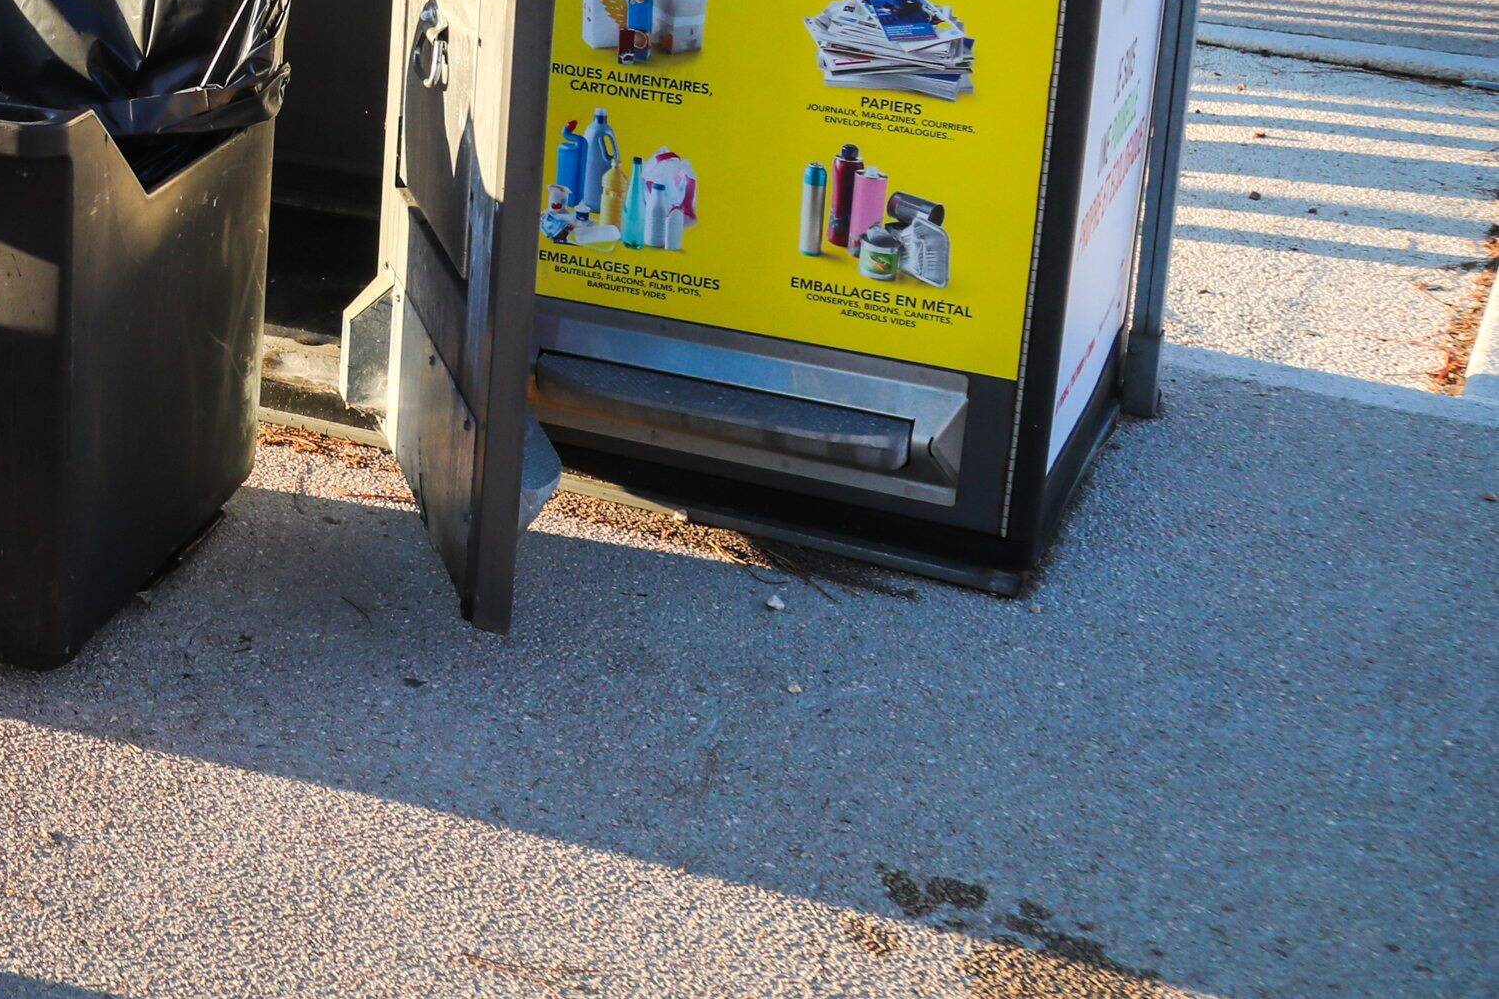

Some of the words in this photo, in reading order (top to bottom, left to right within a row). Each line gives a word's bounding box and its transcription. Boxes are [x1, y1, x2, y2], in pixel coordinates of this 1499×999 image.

[550, 62, 603, 80] RIQUES
[607, 70, 713, 97] ALIMENTAIRES,
[570, 79, 683, 106] CARTONNETTES
[806, 103, 859, 118] JOURNAUX,
[861, 111, 919, 126] MAGAZINES,
[921, 119, 976, 134] COURRIERS,
[860, 96, 922, 115] PAPIERS
[824, 115, 885, 132] ENVELOPPES,
[539, 249, 630, 275] EMBALLAGES
[634, 266, 721, 290] PLASTIQUES
[554, 265, 604, 280] BOUTEILLES,
[606, 274, 647, 288] FLACONS,
[649, 282, 676, 293] FILMS,
[677, 287, 702, 298] POTS,
[587, 280, 640, 296] BARQUETTES
[642, 290, 667, 301] VIDES
[790, 277, 891, 304] EMBALLAGES
[895, 295, 917, 308] EN
[921, 297, 973, 319] MÉTAL
[806, 293, 862, 310] CONSERVES,
[864, 303, 901, 316] BIDONS,
[904, 310, 954, 326] CANETTES,
[840, 308, 888, 323] AÉROSOLS
[890, 317, 917, 329] VIDES
